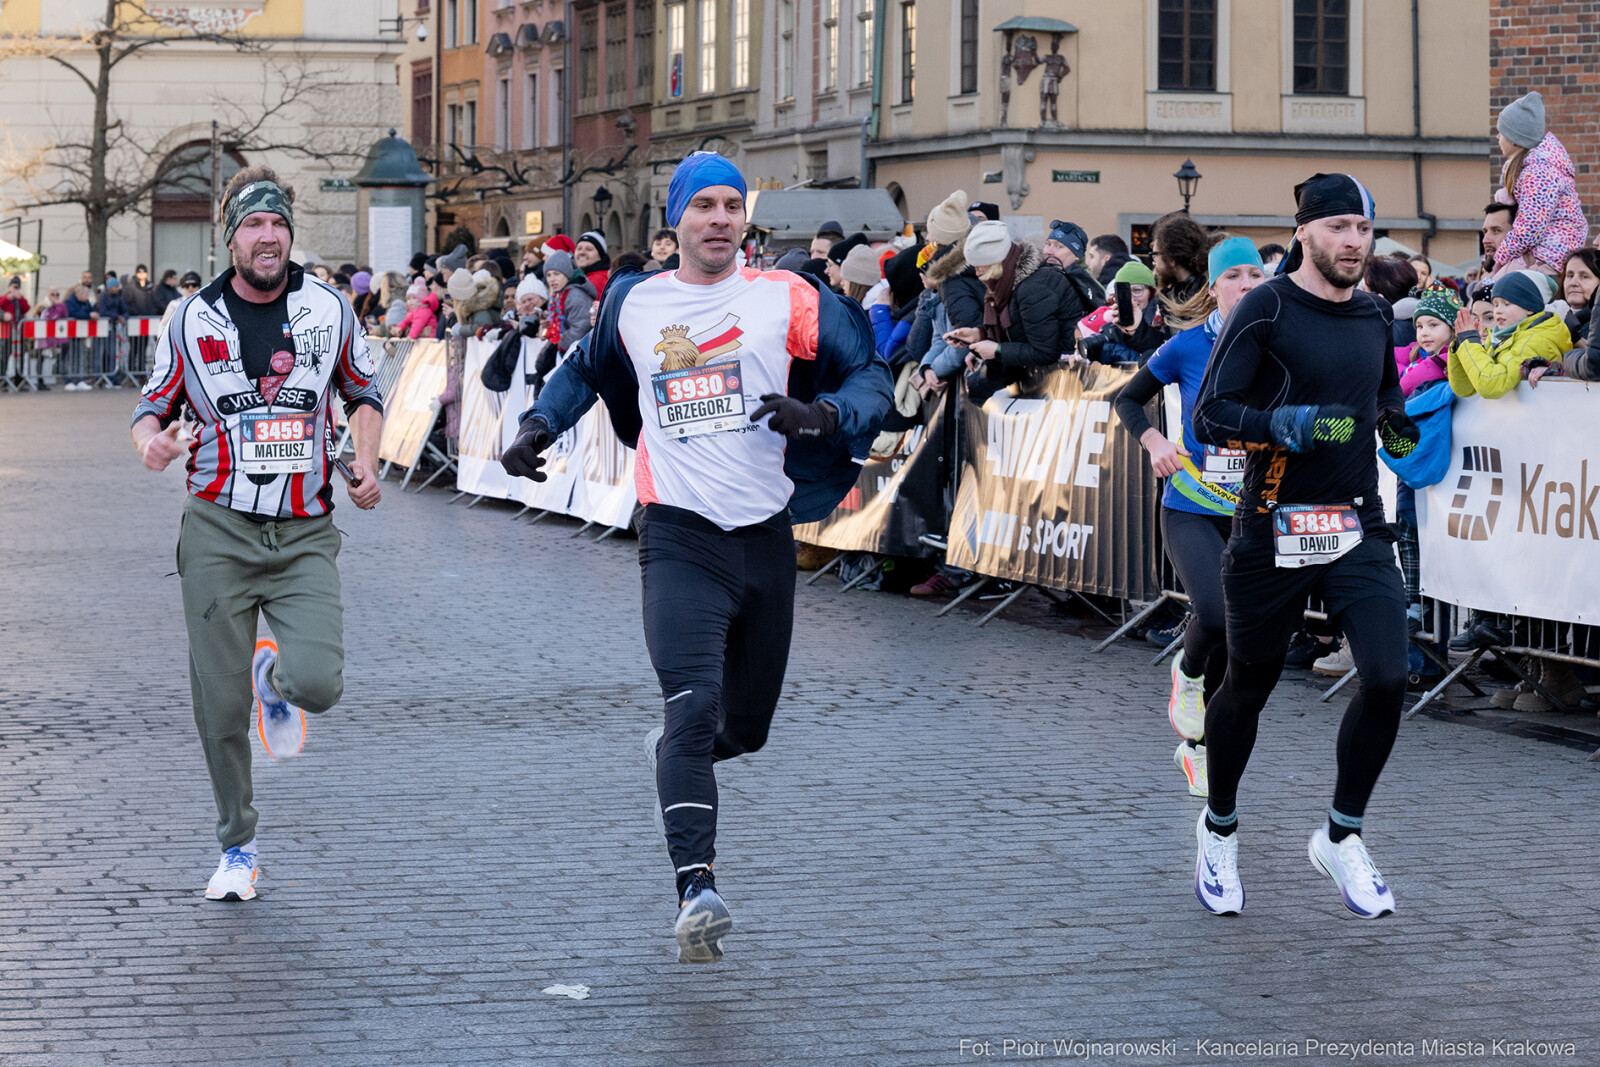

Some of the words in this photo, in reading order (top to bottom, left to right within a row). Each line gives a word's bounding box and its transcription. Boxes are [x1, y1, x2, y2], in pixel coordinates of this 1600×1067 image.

[238, 184, 255, 202] NIKE
[669, 374, 724, 401] 3930
[667, 397, 733, 422] GRZEGORZ
[257, 420, 304, 440] 3459
[254, 442, 306, 458] MATEUSZ
[1516, 458, 1600, 541] Krak
[1293, 513, 1342, 533] 3834
[1017, 516, 1032, 552] is
[1032, 518, 1094, 560] SPORT
[1300, 535, 1339, 552] DAWID
